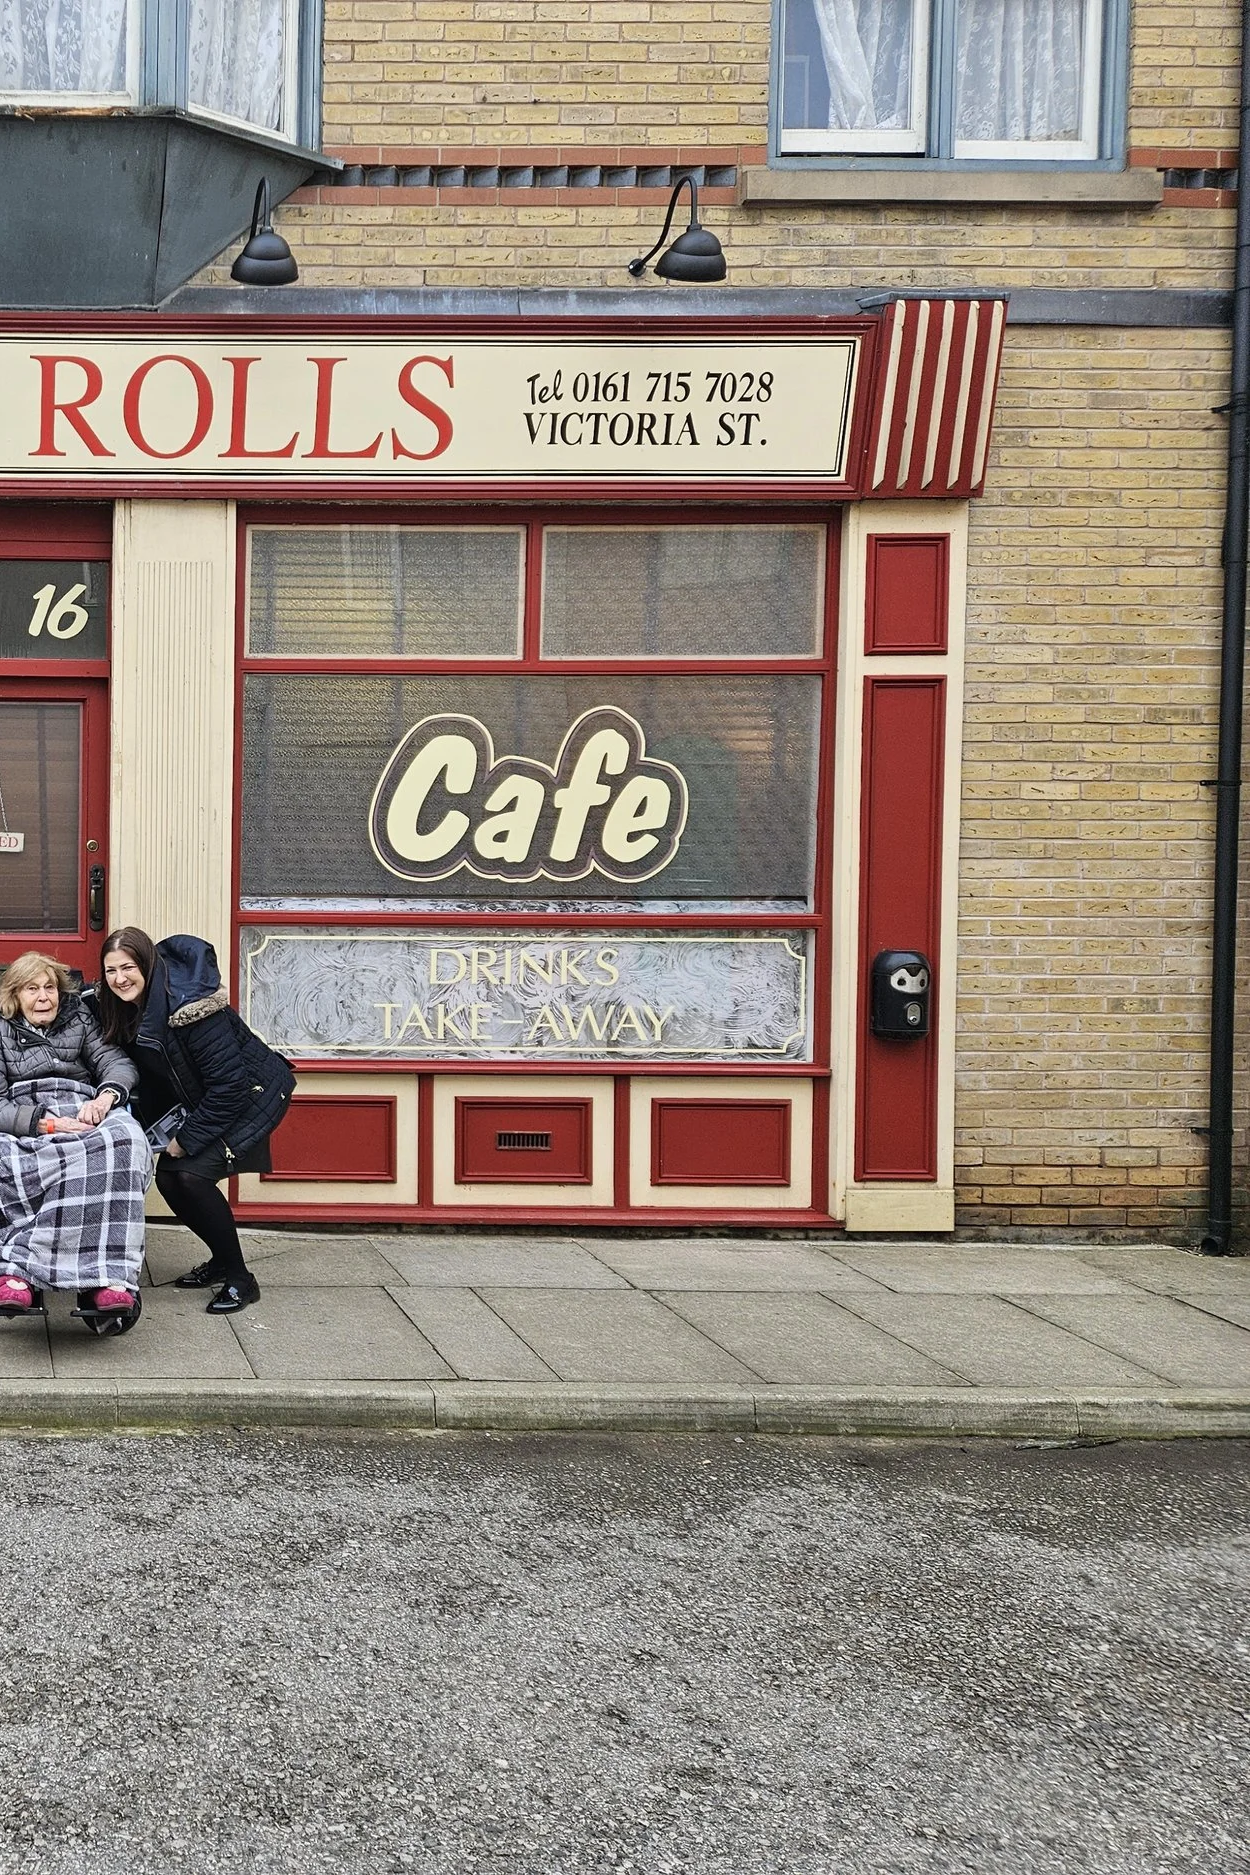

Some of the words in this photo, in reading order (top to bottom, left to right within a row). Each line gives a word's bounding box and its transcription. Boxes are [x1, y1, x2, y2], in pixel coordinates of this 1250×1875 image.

[28, 354, 454, 461] ROLLS
[526, 369, 564, 405] Tel
[572, 371, 630, 402] 0161
[646, 371, 692, 402] 715
[705, 371, 775, 402] 7028
[523, 411, 700, 446] VICTORIA
[716, 411, 767, 446] ST.
[28, 583, 89, 640] 16
[387, 728, 671, 863] Cafe
[429, 948, 620, 986] DRINKS
